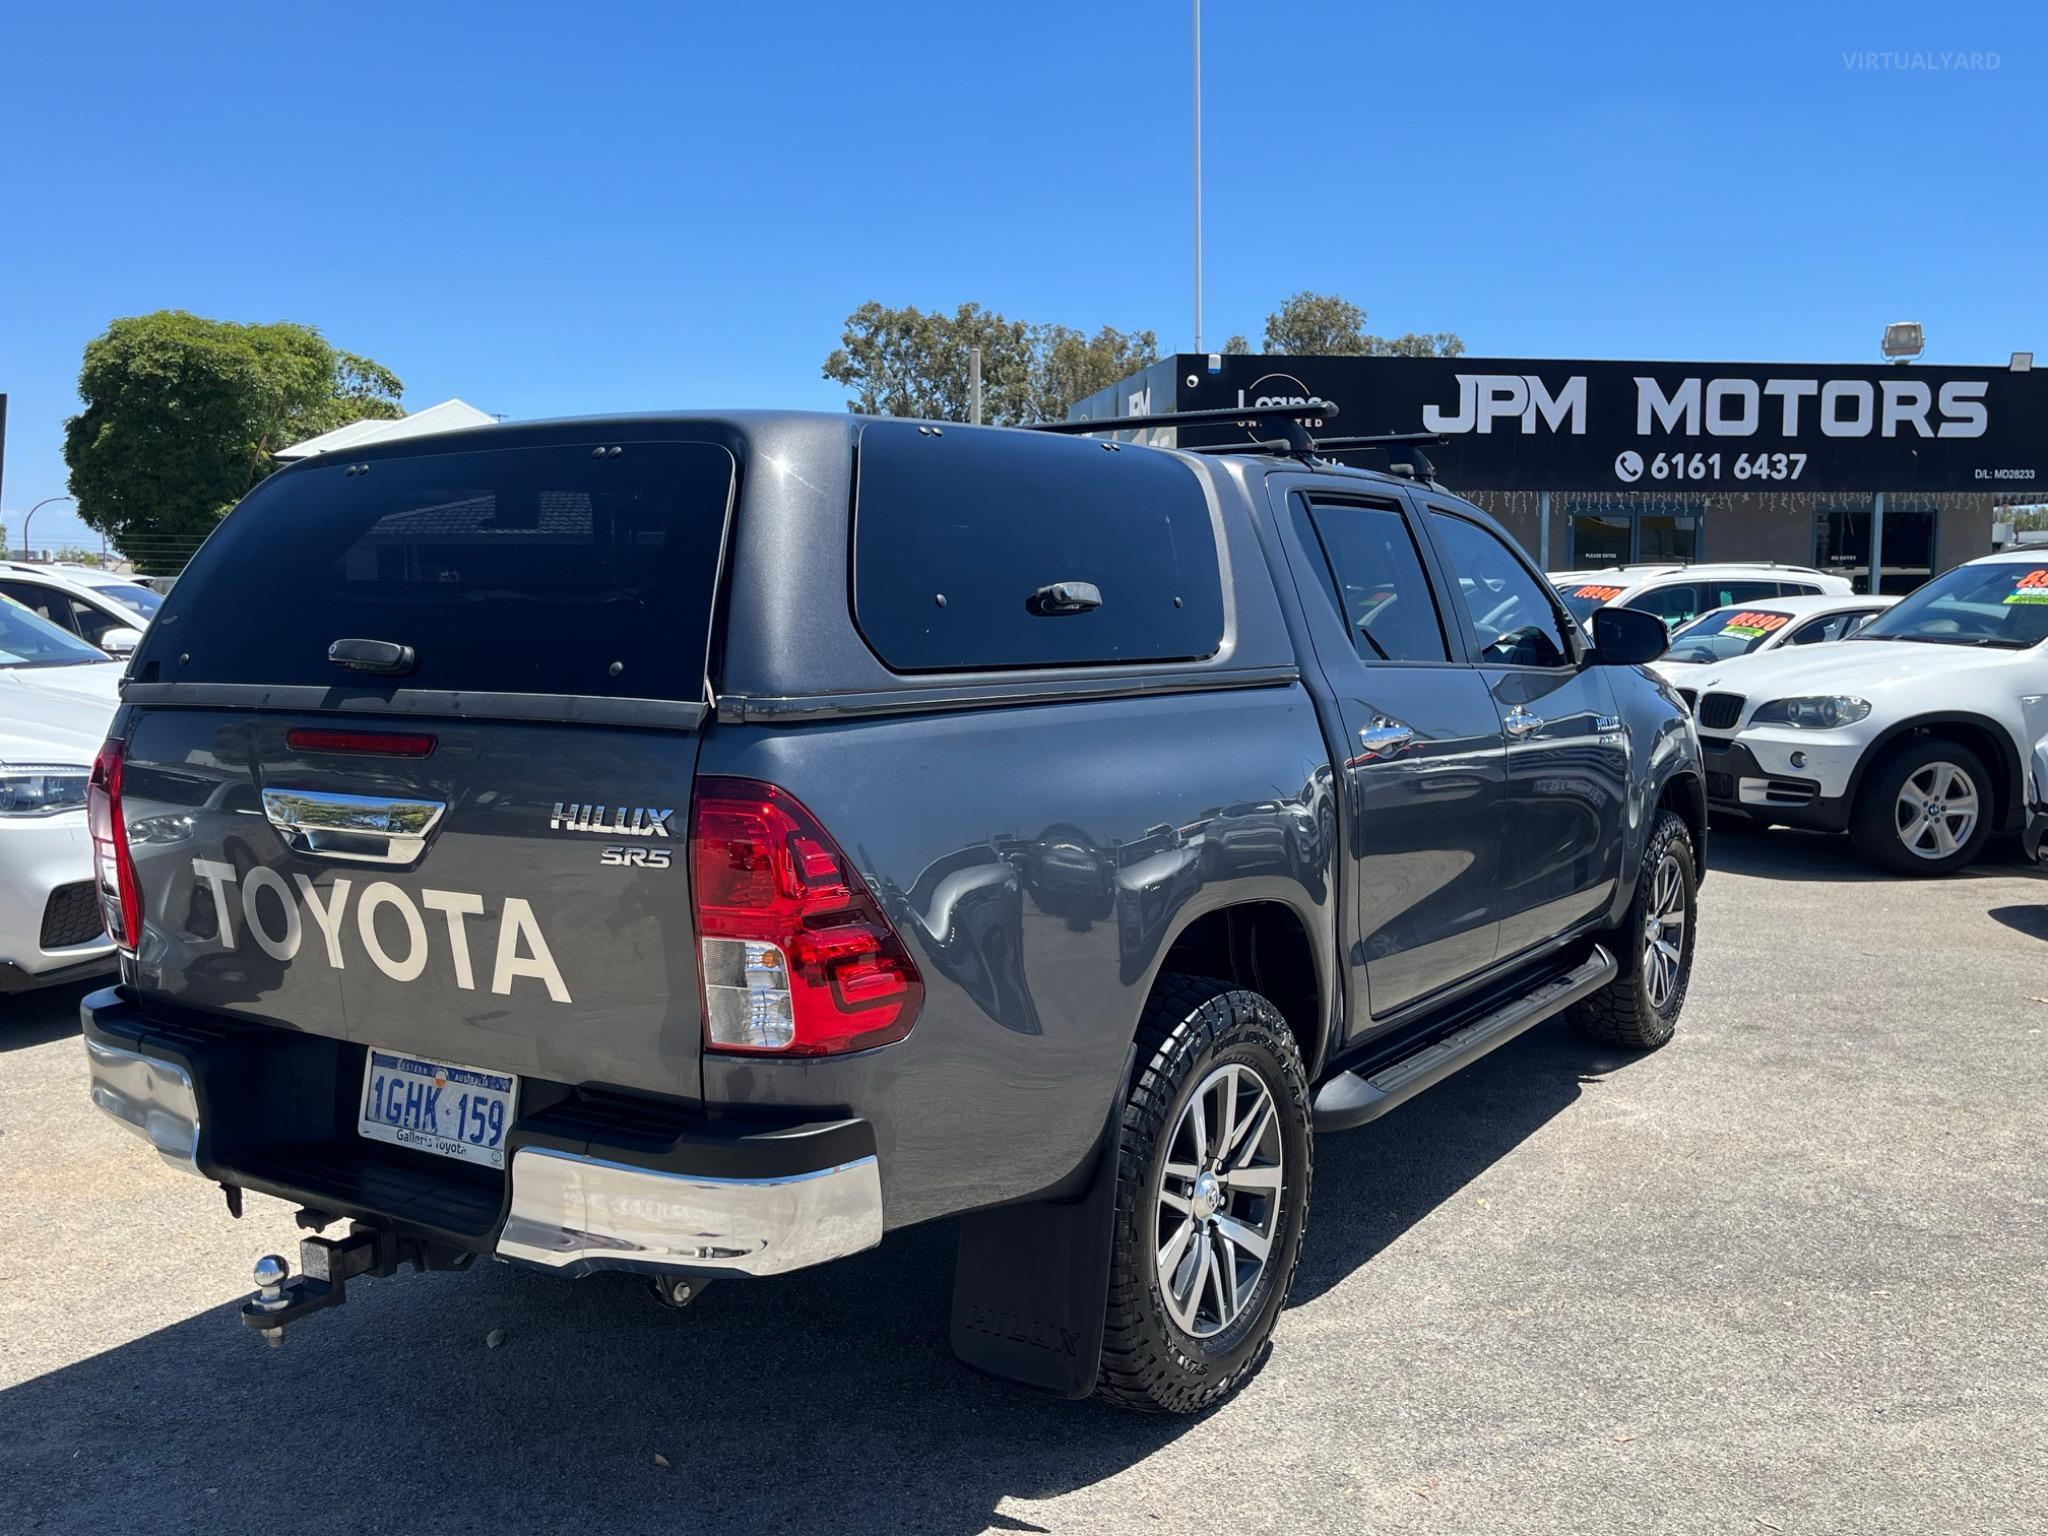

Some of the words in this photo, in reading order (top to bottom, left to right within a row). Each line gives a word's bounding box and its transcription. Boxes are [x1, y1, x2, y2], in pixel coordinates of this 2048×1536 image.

[1423, 374, 1587, 434] JPM
[1633, 377, 1989, 438] MOTORS
[1651, 453, 1721, 480] 6161
[1733, 453, 1807, 480] 6437
[1974, 469, 1992, 480] D/L:
[550, 802, 674, 837] HILUX
[600, 845, 672, 869] SR5
[193, 858, 572, 1003] TOYOTA
[374, 1075, 443, 1135] 1GHK
[457, 1092, 504, 1147] 159
